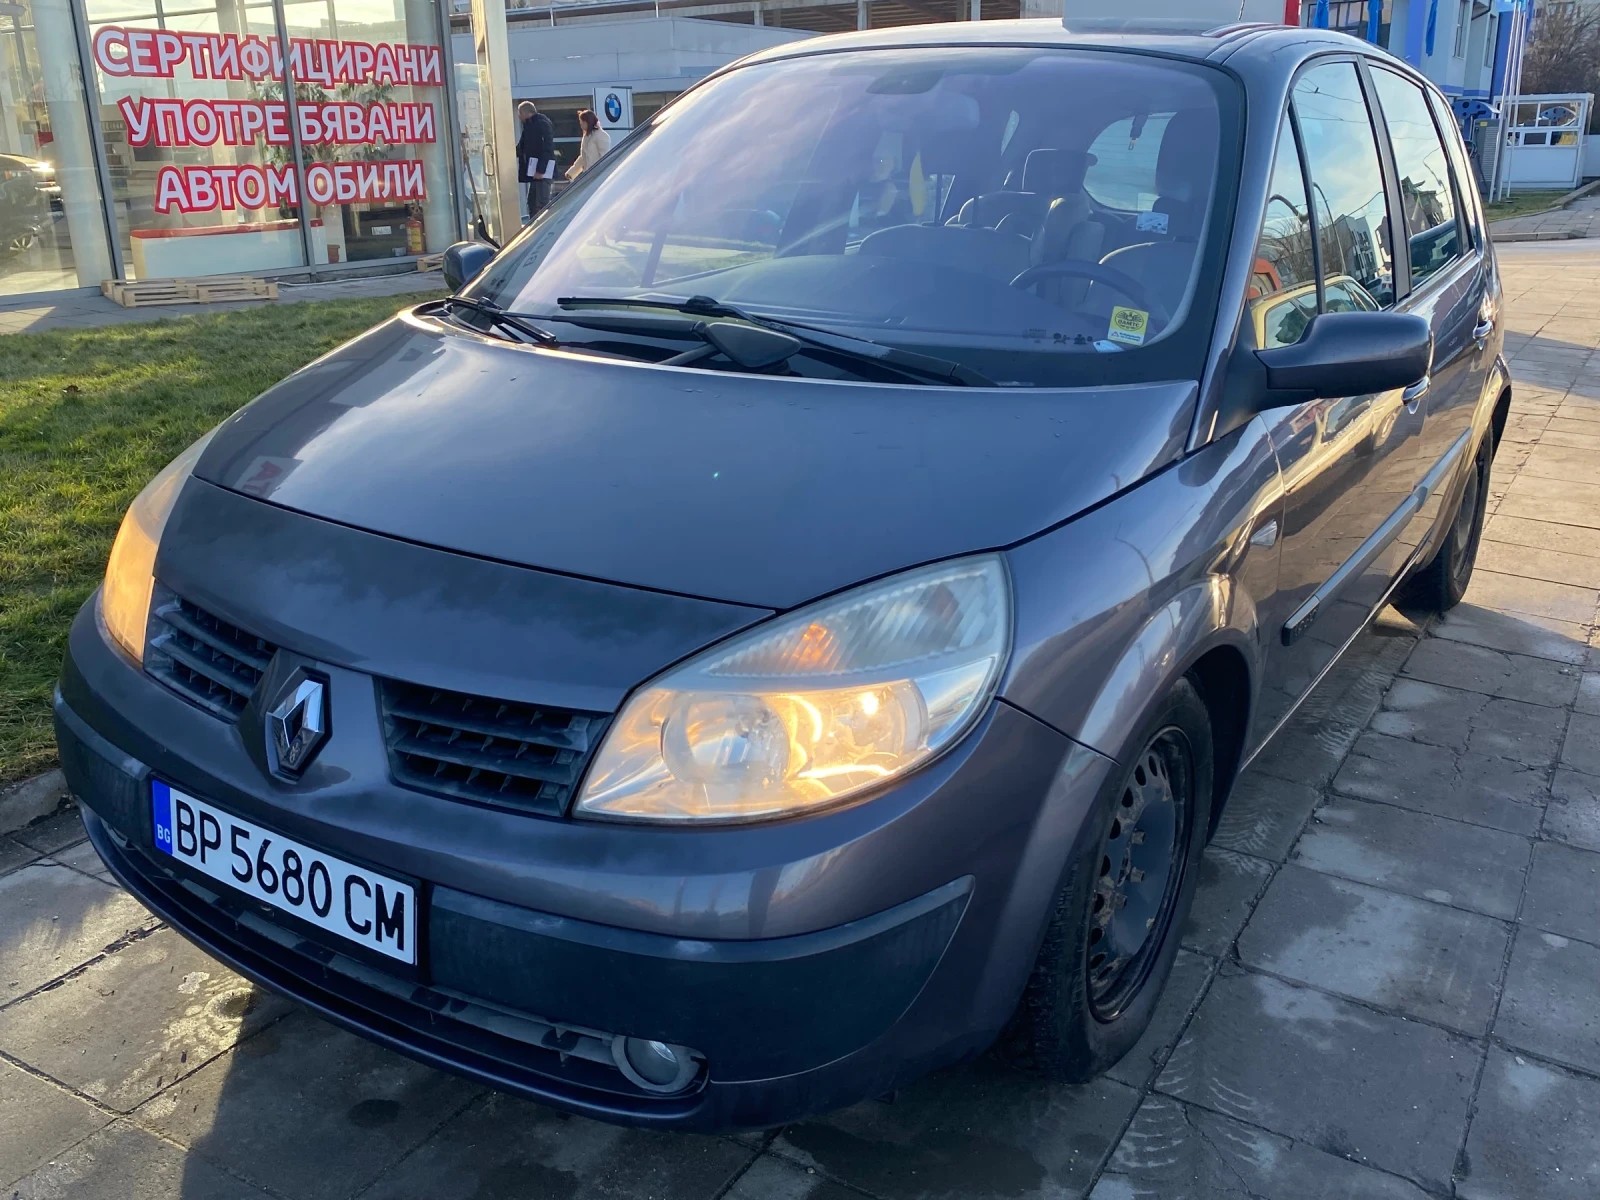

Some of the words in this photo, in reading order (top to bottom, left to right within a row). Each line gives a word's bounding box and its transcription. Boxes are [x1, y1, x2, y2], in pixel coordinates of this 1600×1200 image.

[93, 26, 443, 89] СЕРТИФИЦИРАНИ
[157, 823, 171, 844] BG
[176, 799, 221, 864] BP
[231, 824, 332, 918] 5680
[344, 874, 405, 951] CM
